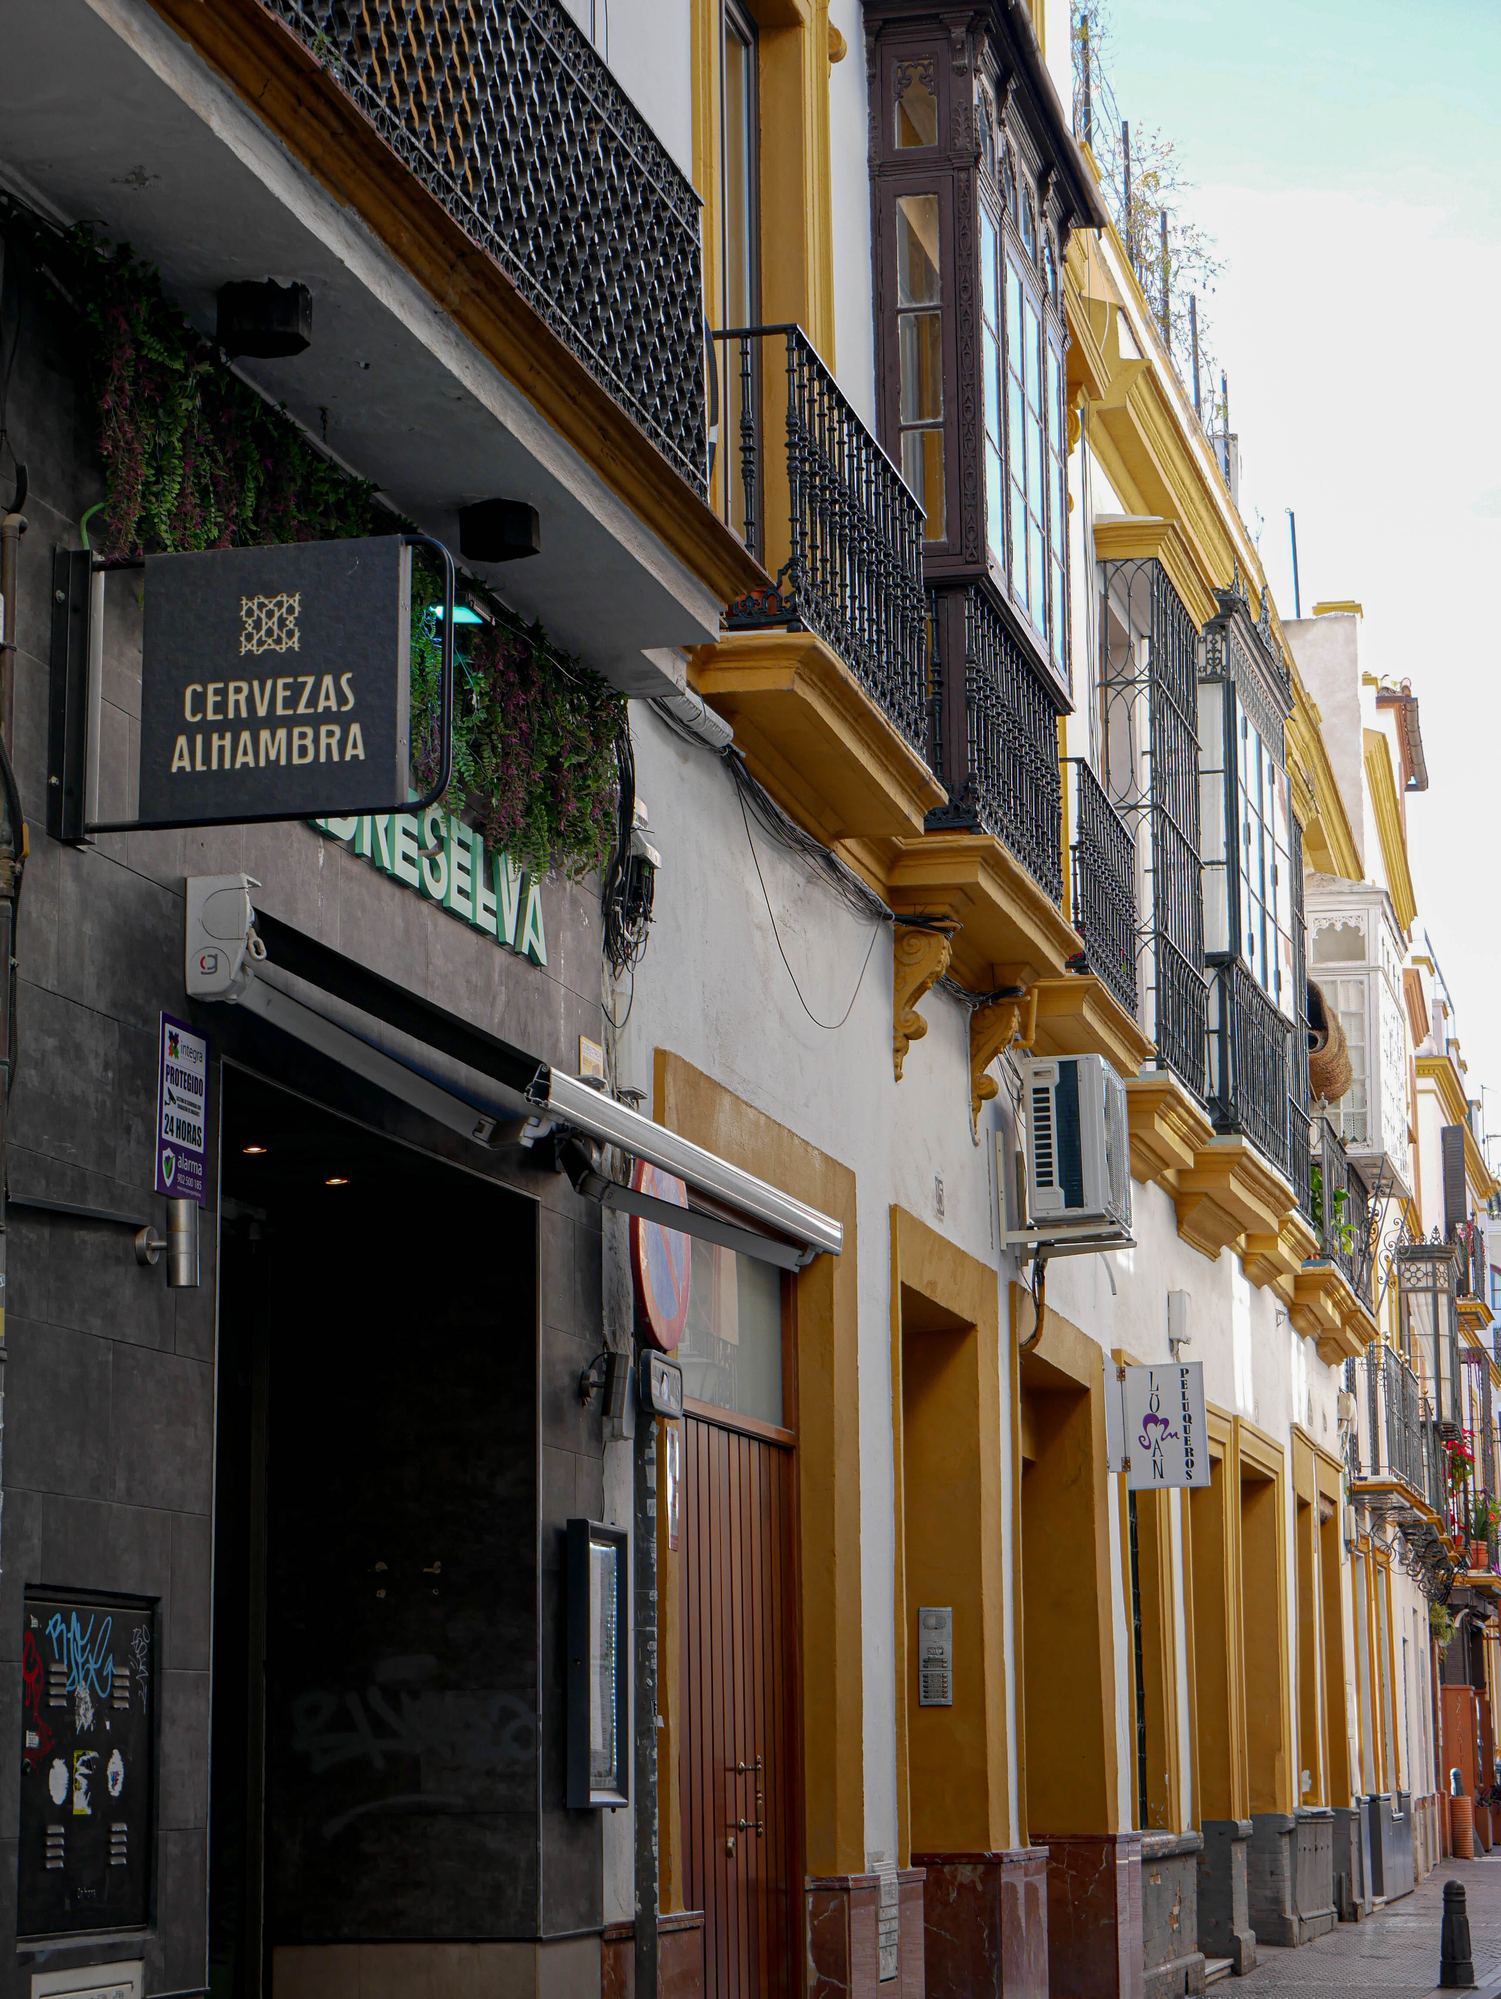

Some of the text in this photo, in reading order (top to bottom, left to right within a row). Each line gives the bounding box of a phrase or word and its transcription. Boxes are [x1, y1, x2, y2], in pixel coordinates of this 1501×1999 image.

[184, 672, 355, 722] CERVEZAS
[171, 723, 366, 773] ALHAMBRA
[310, 803, 548, 967] RESELVA
[180, 1039, 203, 1064] integra
[166, 1063, 204, 1097] PROTEGIDO
[164, 1113, 203, 1149] 24 HORAS
[177, 1152, 203, 1176] alarma
[1179, 1367, 1195, 1481] PELUQUEROS
